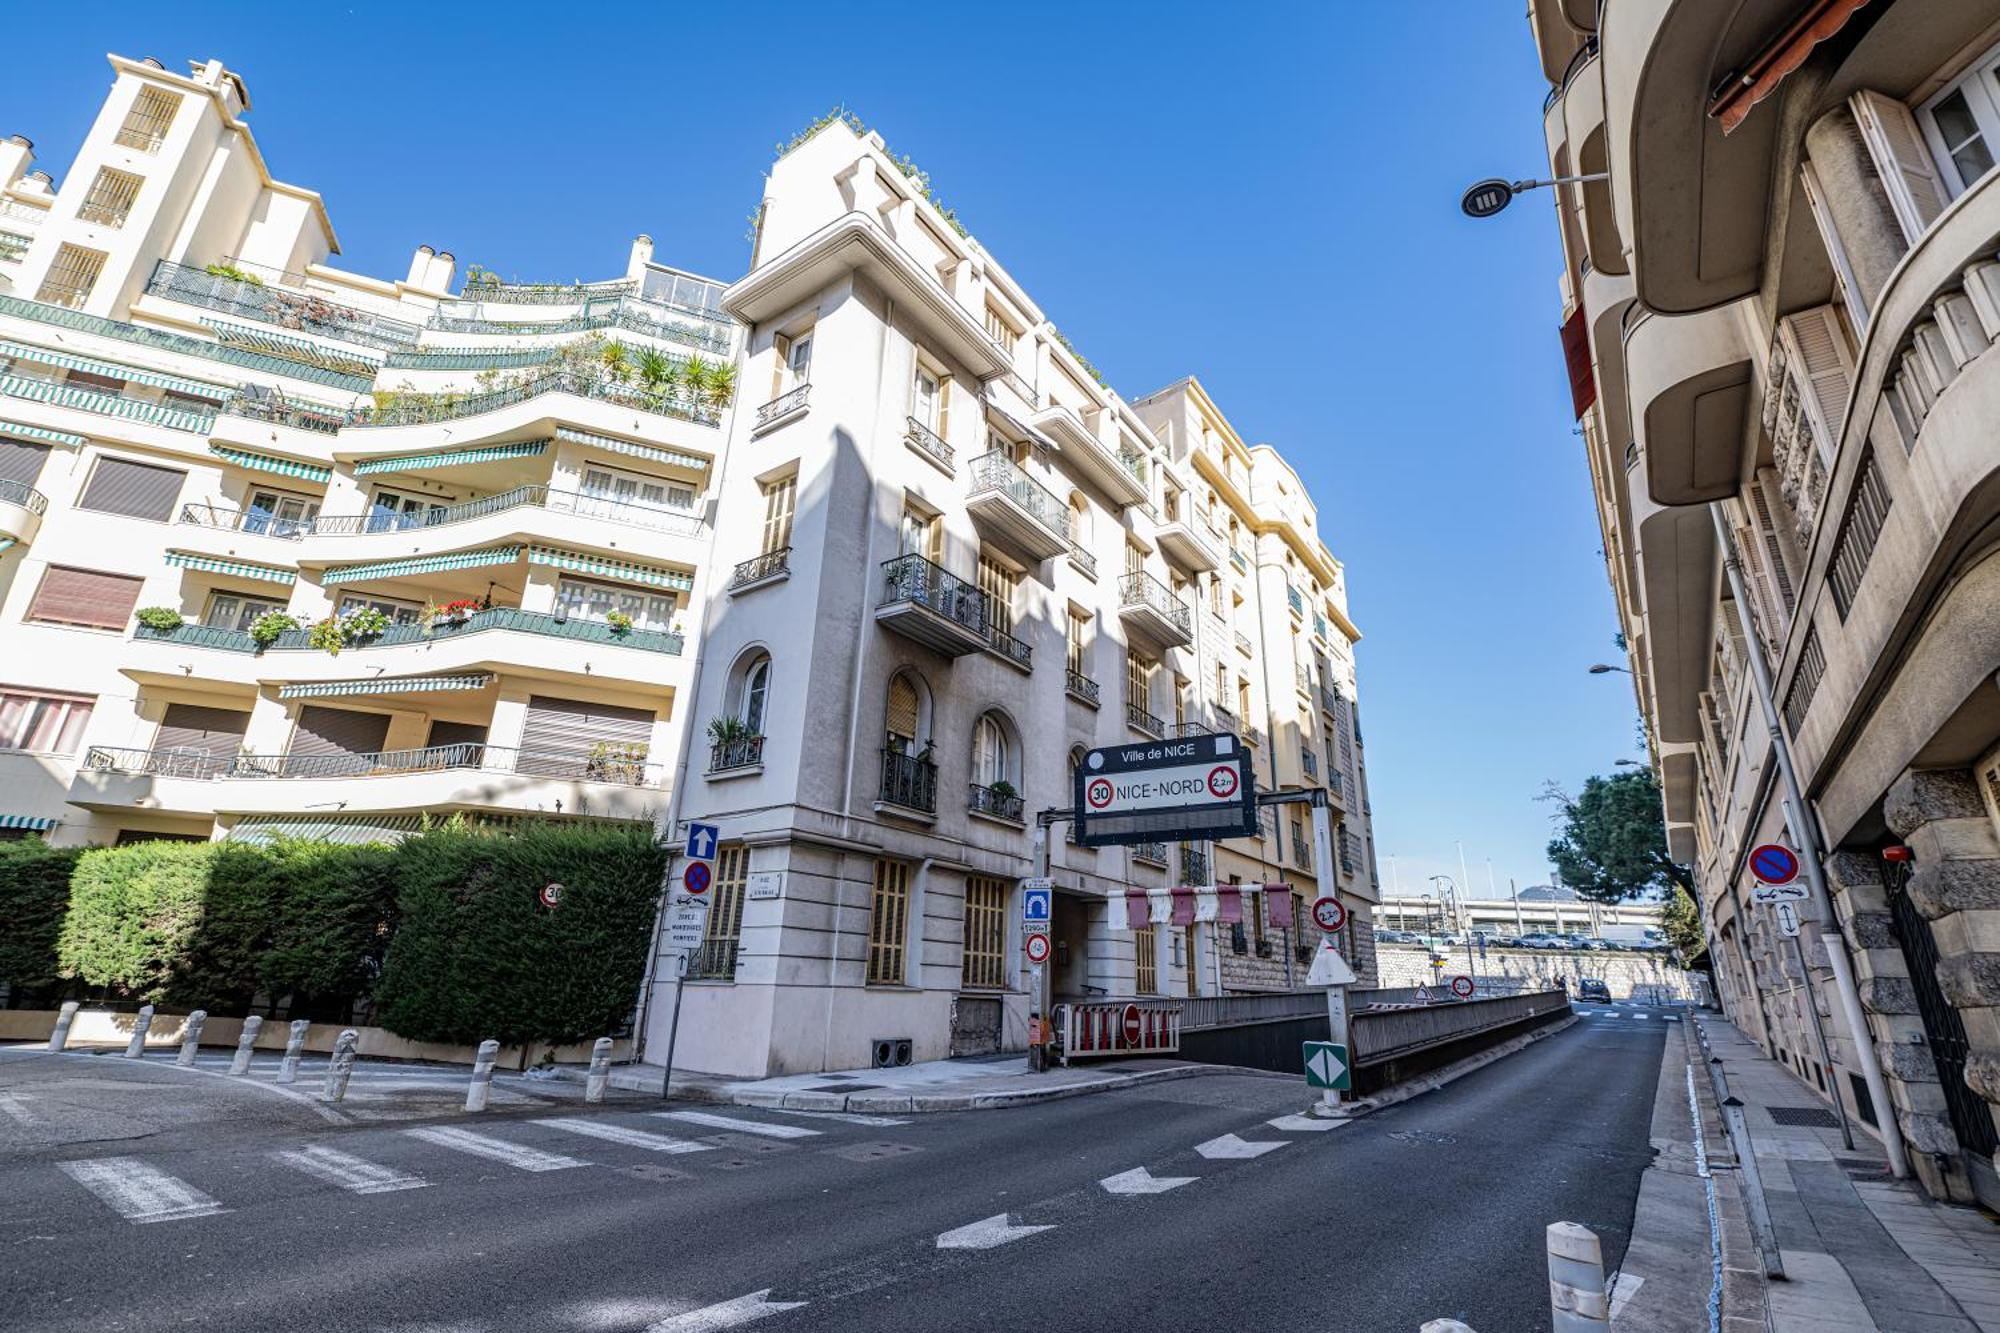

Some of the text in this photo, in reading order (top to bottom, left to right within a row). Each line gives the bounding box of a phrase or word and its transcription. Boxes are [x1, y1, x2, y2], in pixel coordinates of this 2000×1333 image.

[1121, 743, 1195, 763] Ville de NICE
[1093, 787, 1109, 801] 30
[1116, 779, 1204, 800] NICE-NORD
